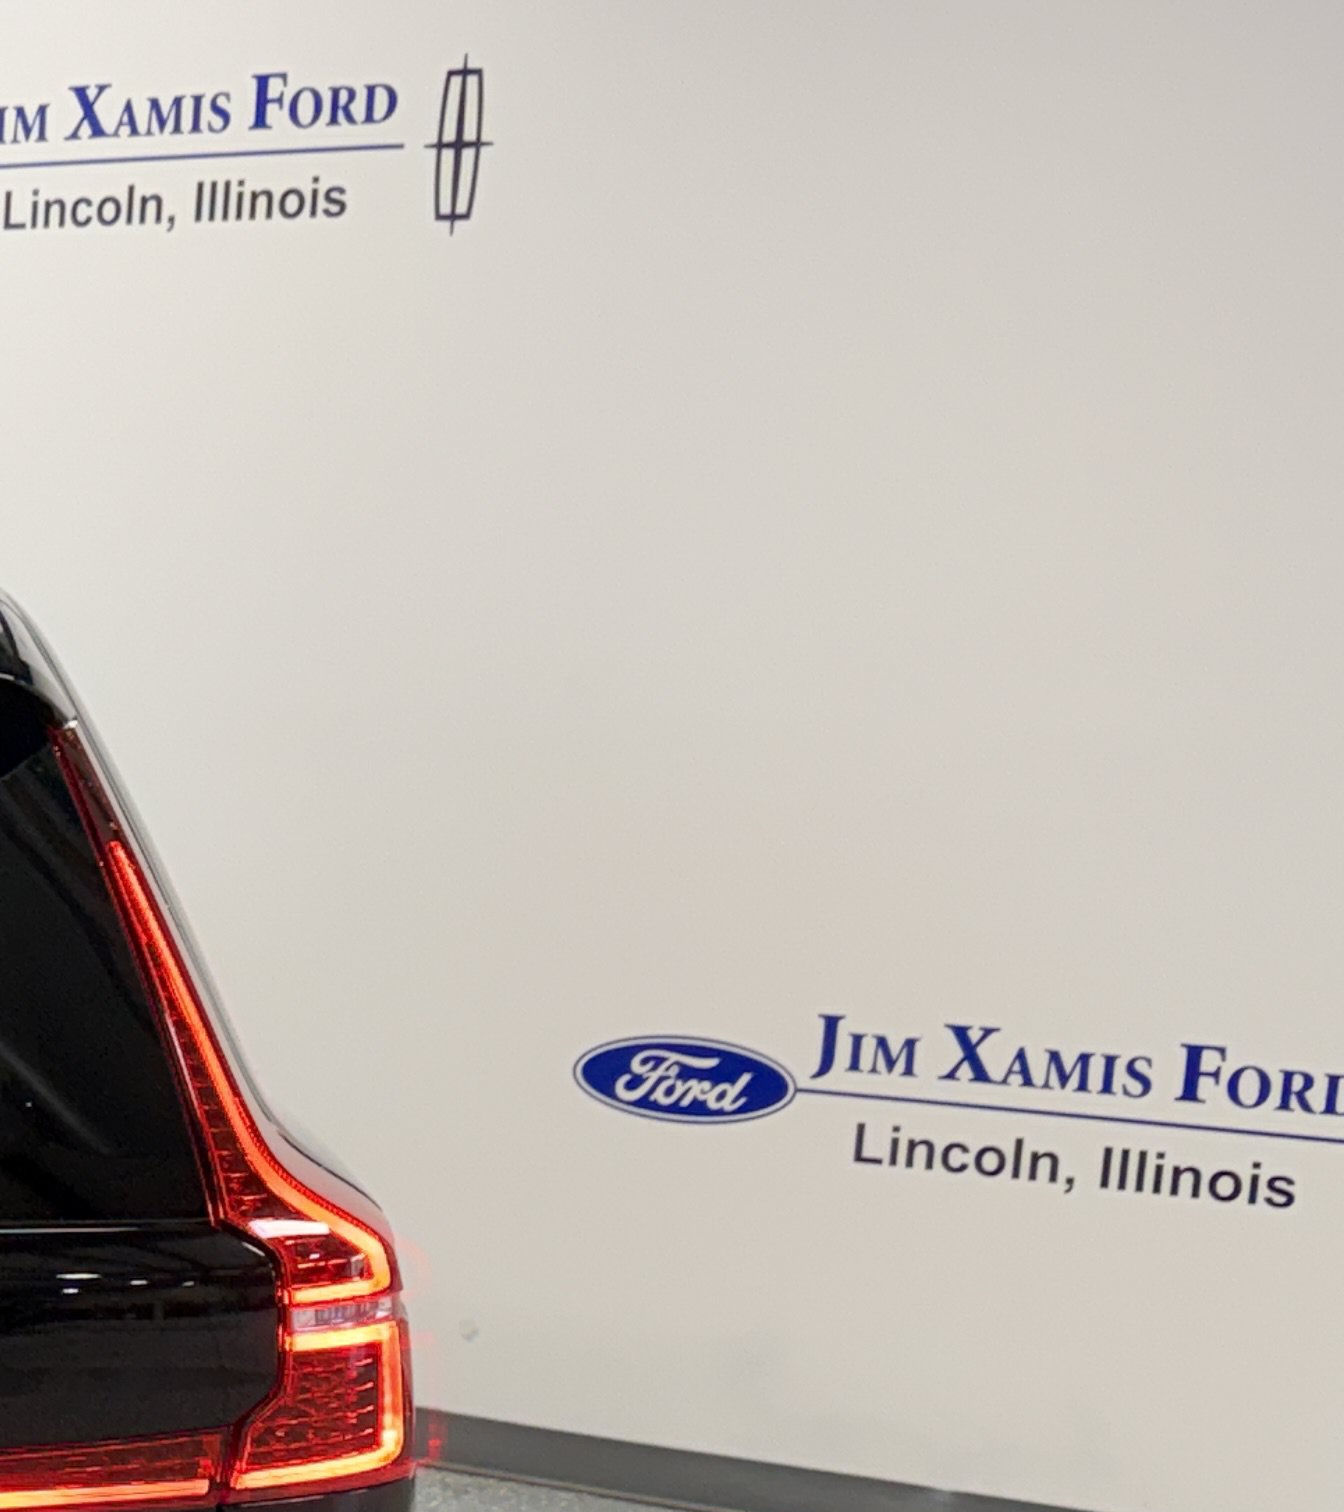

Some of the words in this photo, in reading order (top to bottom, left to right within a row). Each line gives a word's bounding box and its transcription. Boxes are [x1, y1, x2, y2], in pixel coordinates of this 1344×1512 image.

[4, 185, 175, 232] Lincoln,
[194, 177, 347, 224] Illinois
[615, 1048, 749, 1113] Ford
[852, 1122, 1076, 1193] Lincoln,
[1099, 1146, 1296, 1209] Illinois
